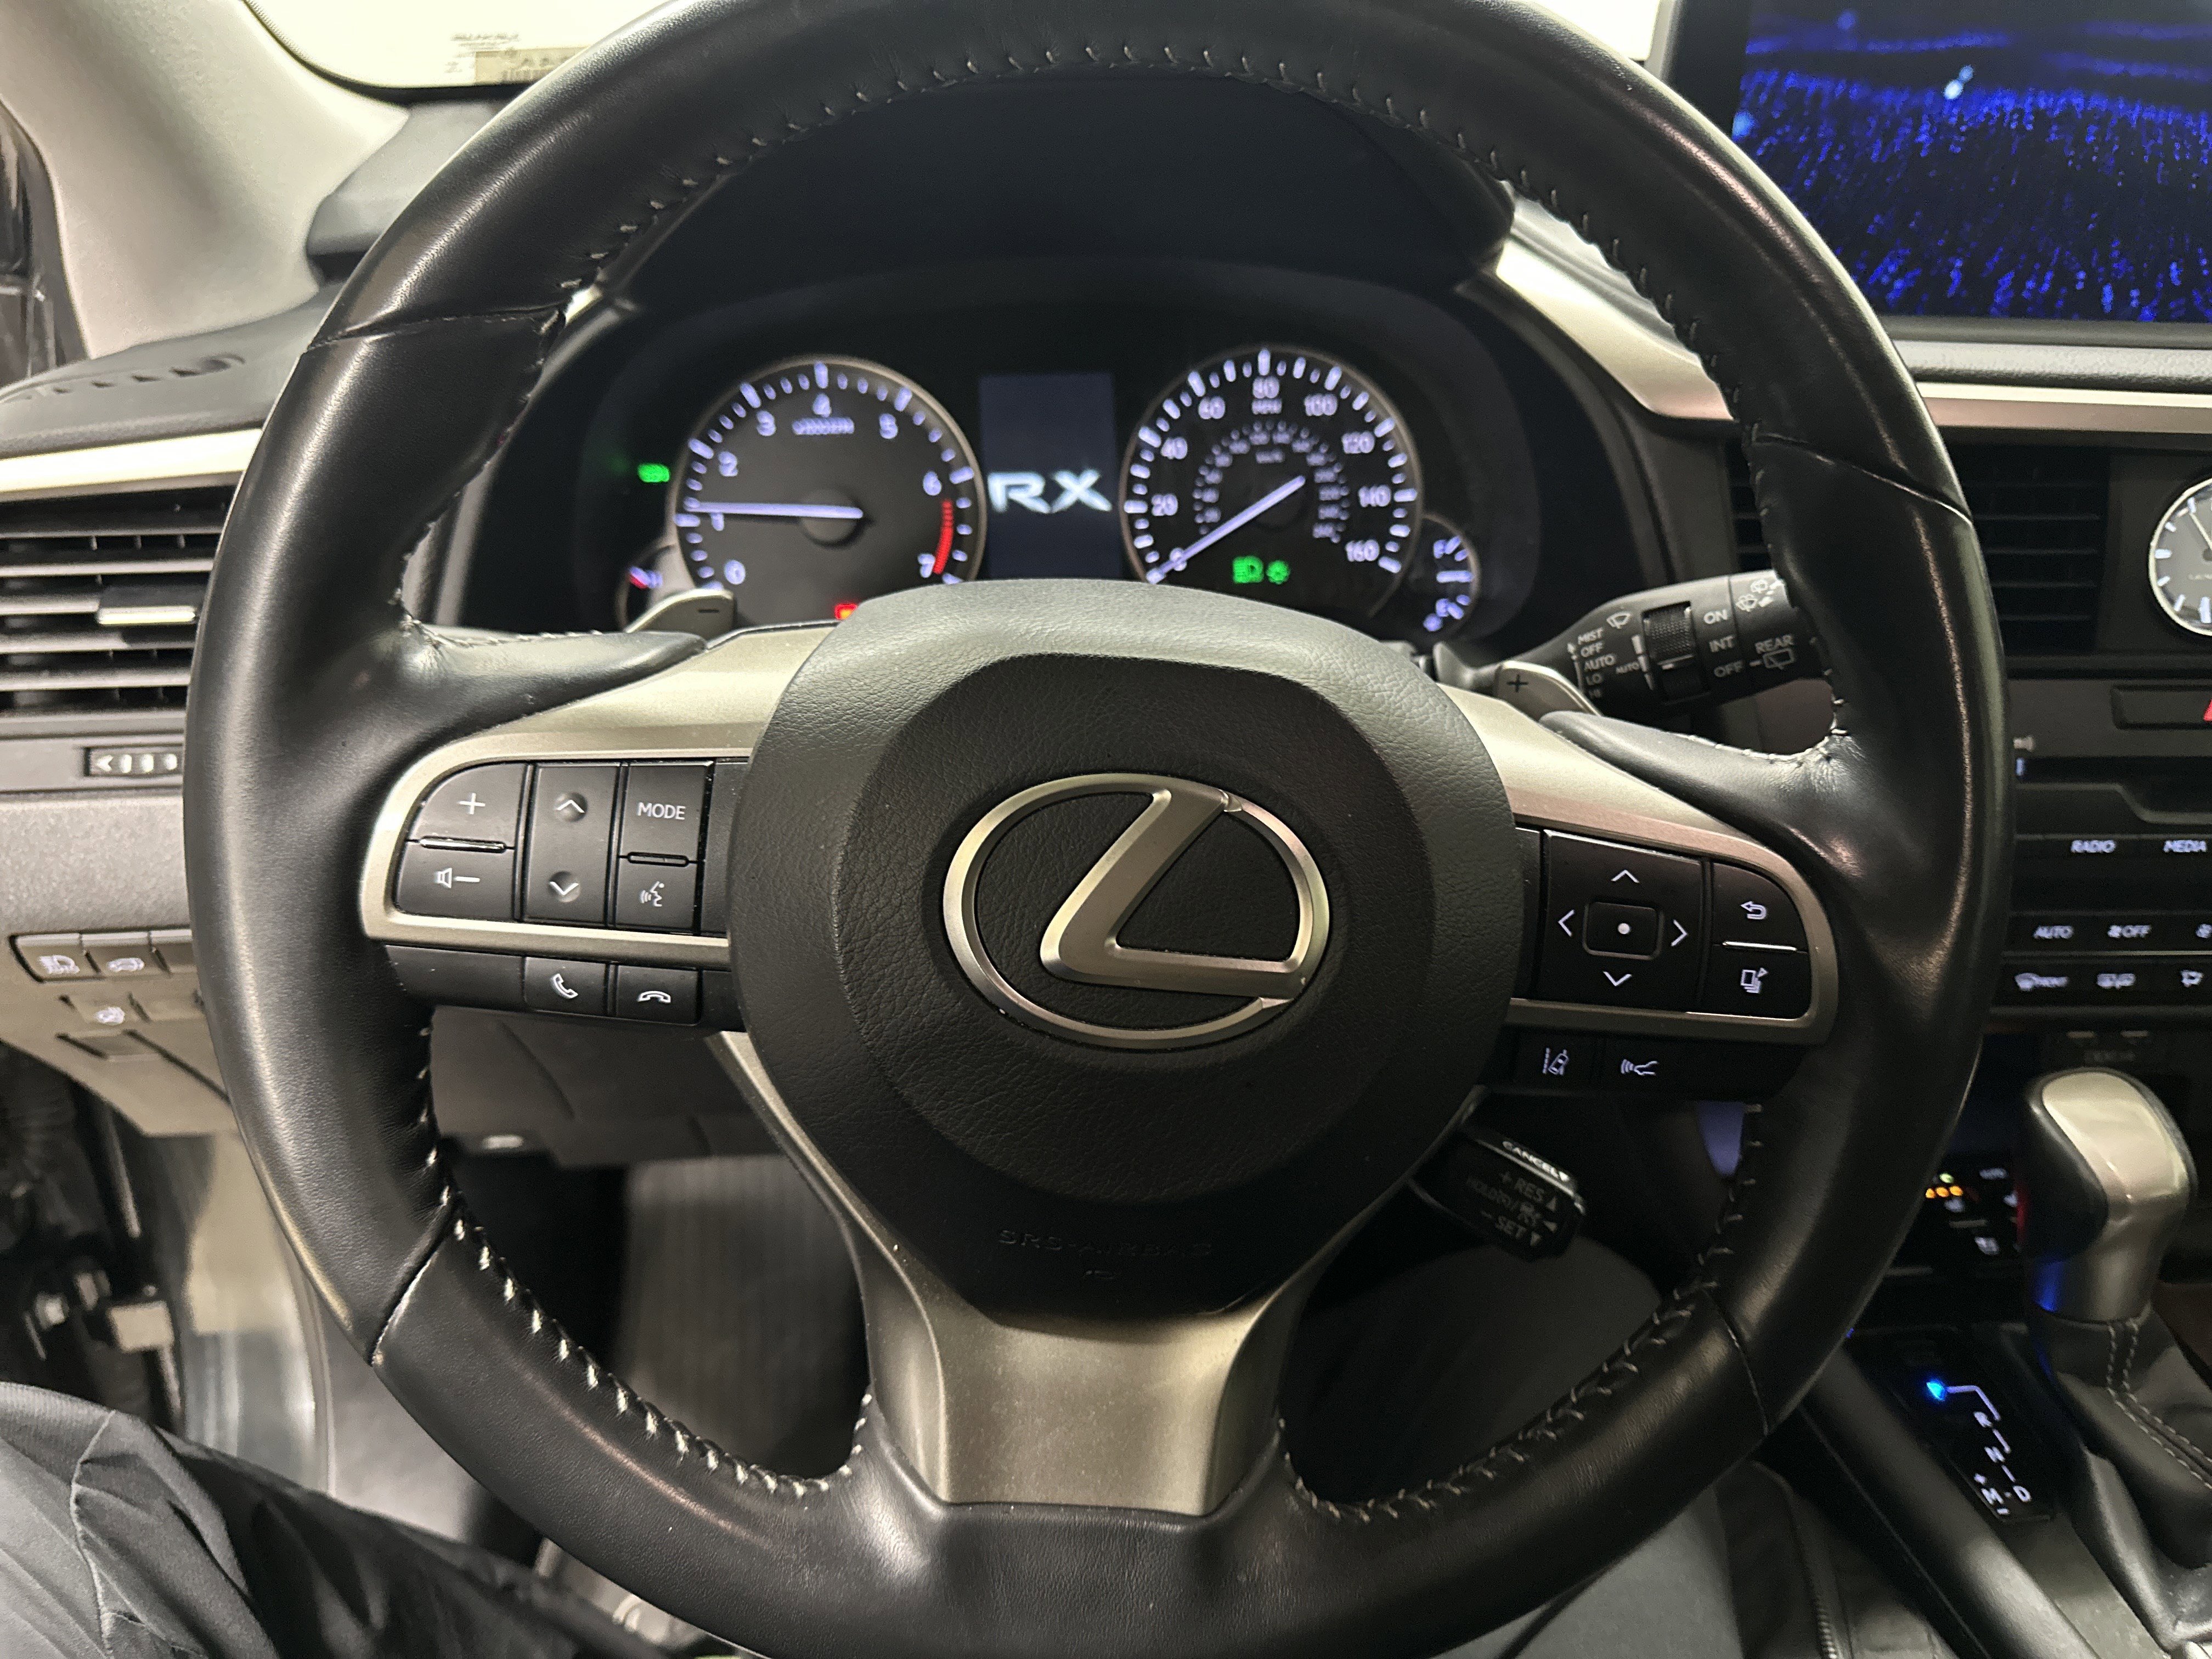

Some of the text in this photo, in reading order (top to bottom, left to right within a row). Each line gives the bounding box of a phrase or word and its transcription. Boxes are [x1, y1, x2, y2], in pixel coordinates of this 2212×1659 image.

[718, 450, 738, 477] 2
[988, 468, 1113, 514] RX
[724, 559, 746, 585] 0
[1703, 609, 1728, 624] ON
[1578, 627, 1604, 645] MIST
[1709, 635, 1735, 653] INT
[1755, 634, 1794, 654] REAR
[1581, 641, 1604, 658] OFF
[1584, 653, 1616, 672] AUTO
[1616, 662, 1640, 674] AUTO
[1714, 660, 1744, 678] OFF
[1586, 673, 1602, 686] LO
[636, 802, 686, 820] MODE
[2070, 839, 2117, 853] RADIO
